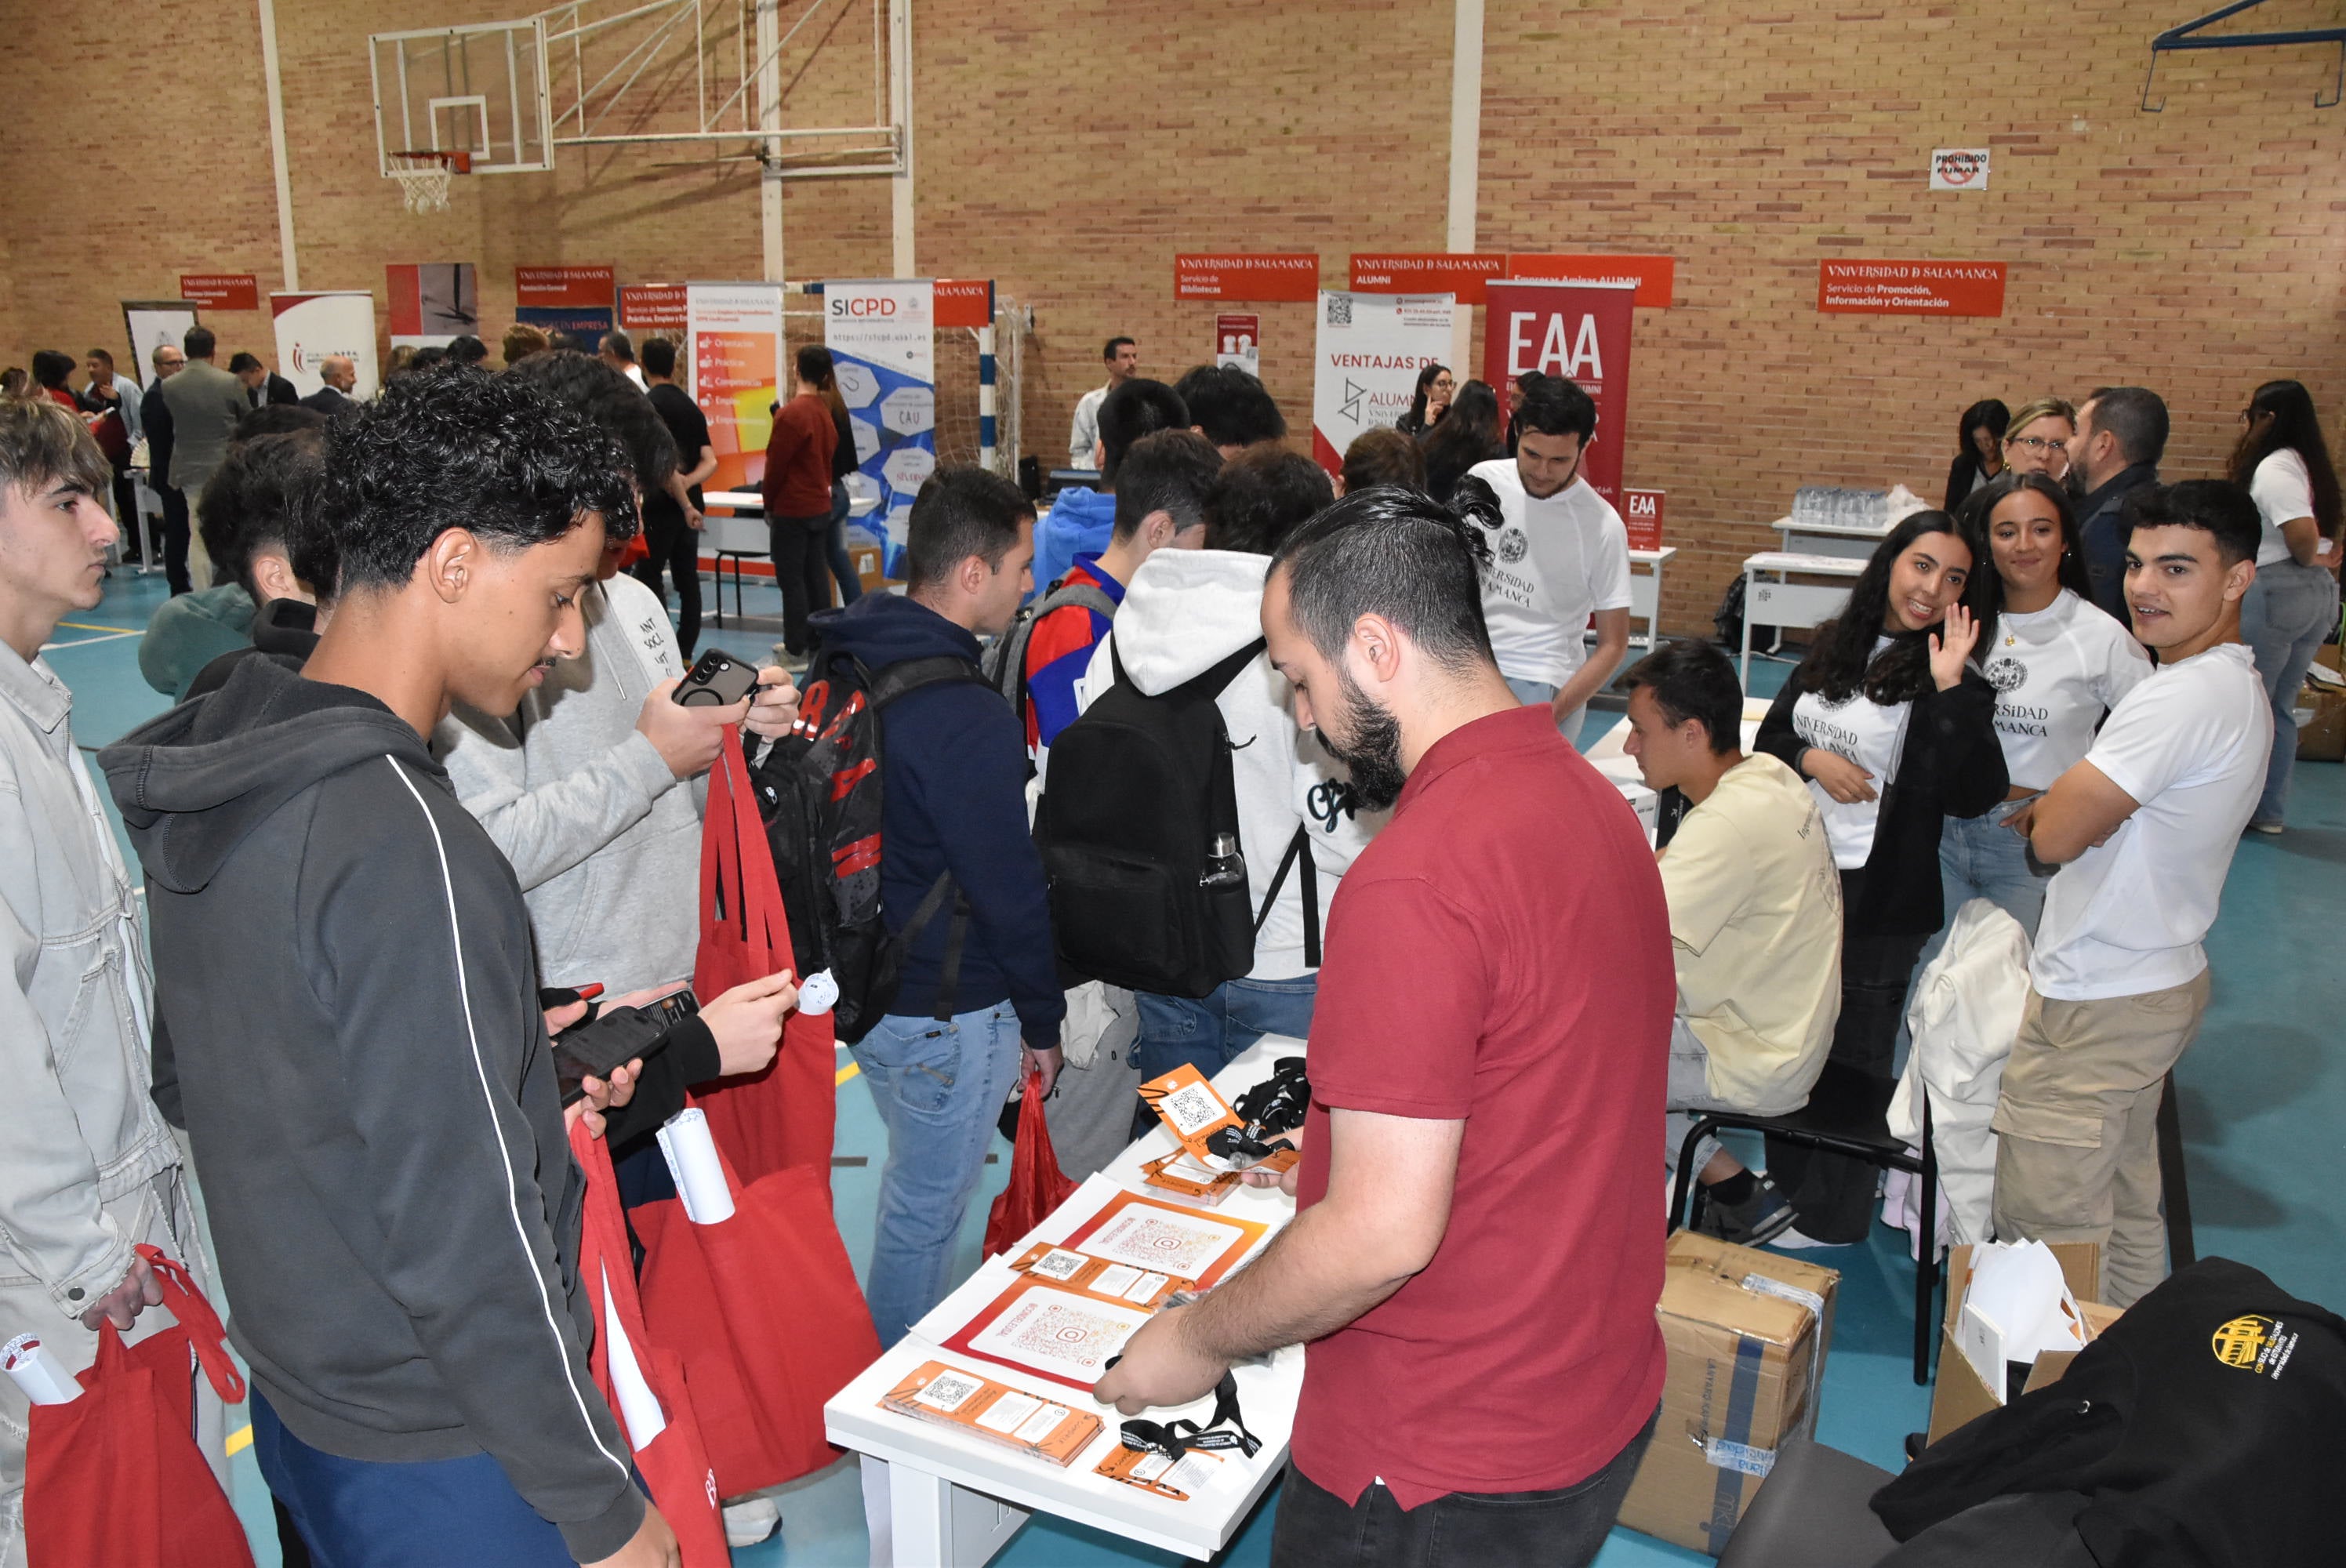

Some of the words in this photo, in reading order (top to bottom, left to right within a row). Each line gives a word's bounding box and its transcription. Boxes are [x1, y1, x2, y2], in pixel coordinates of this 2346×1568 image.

[1936, 154, 1986, 164] PROHIBIDO
[1255, 260, 1313, 269] SALAMANCA
[1436, 260, 1499, 270] SALAMANCA
[1181, 274, 1208, 283] Servicio
[1923, 267, 1998, 279] SALAMANCA
[1356, 275, 1391, 285] ALUMNI
[1181, 285, 1221, 294] Bibliotecas
[1827, 284, 1863, 293] Servicio
[1865, 284, 1875, 293] de
[1877, 284, 1931, 296] Promoción,
[831, 298, 896, 316] SICPD
[1826, 296, 1882, 306] Información
[1884, 299, 1890, 307] y
[1892, 297, 1949, 307] Orientación
[1507, 311, 1603, 379] EAA
[1331, 354, 1414, 369] VENTAJAS
[899, 410, 921, 425] CAU
[1629, 495, 1656, 515] EAA
[1794, 712, 1858, 746] NIVERSIDAD
